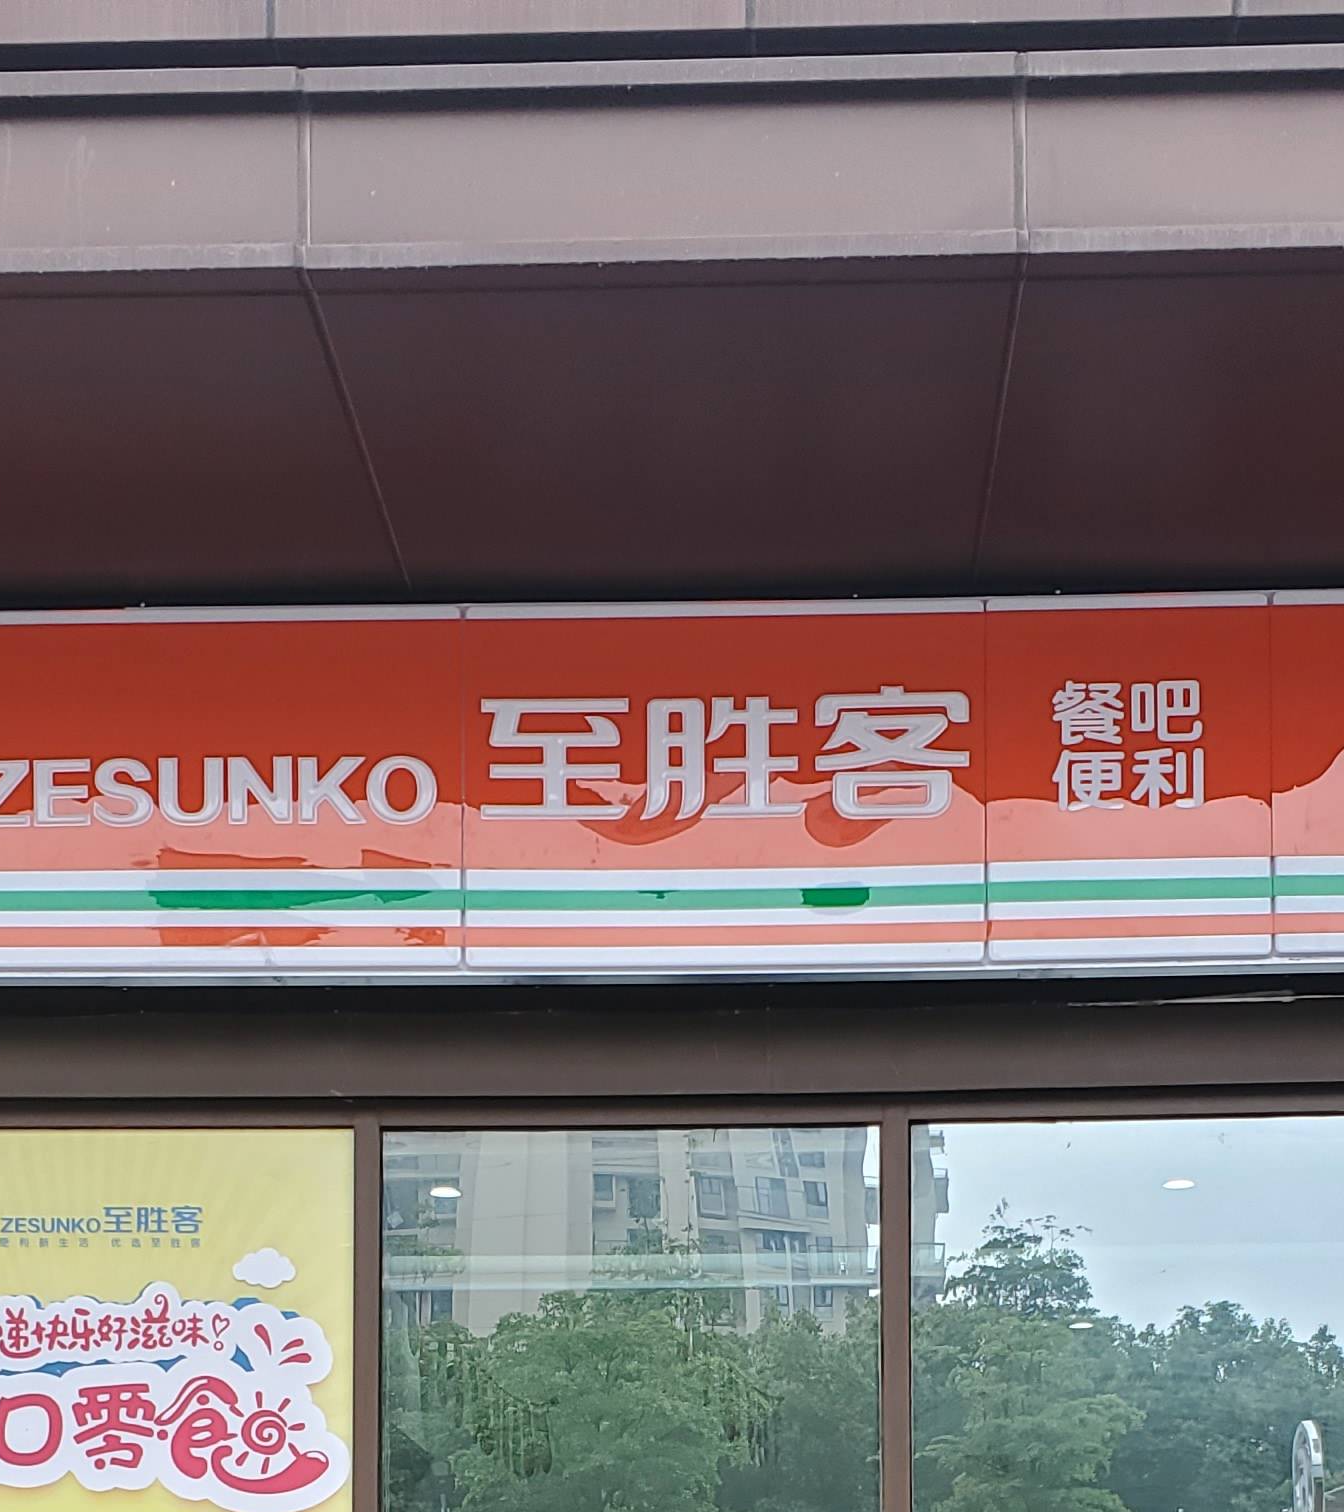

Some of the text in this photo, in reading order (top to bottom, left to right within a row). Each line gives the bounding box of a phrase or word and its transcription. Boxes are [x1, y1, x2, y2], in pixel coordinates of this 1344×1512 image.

[1051, 679, 1204, 746] 餐吧
[480, 686, 971, 823] 至胜客
[1051, 747, 1206, 811] 便利
[0, 1205, 203, 1234] ZESUNKO 至胜客
